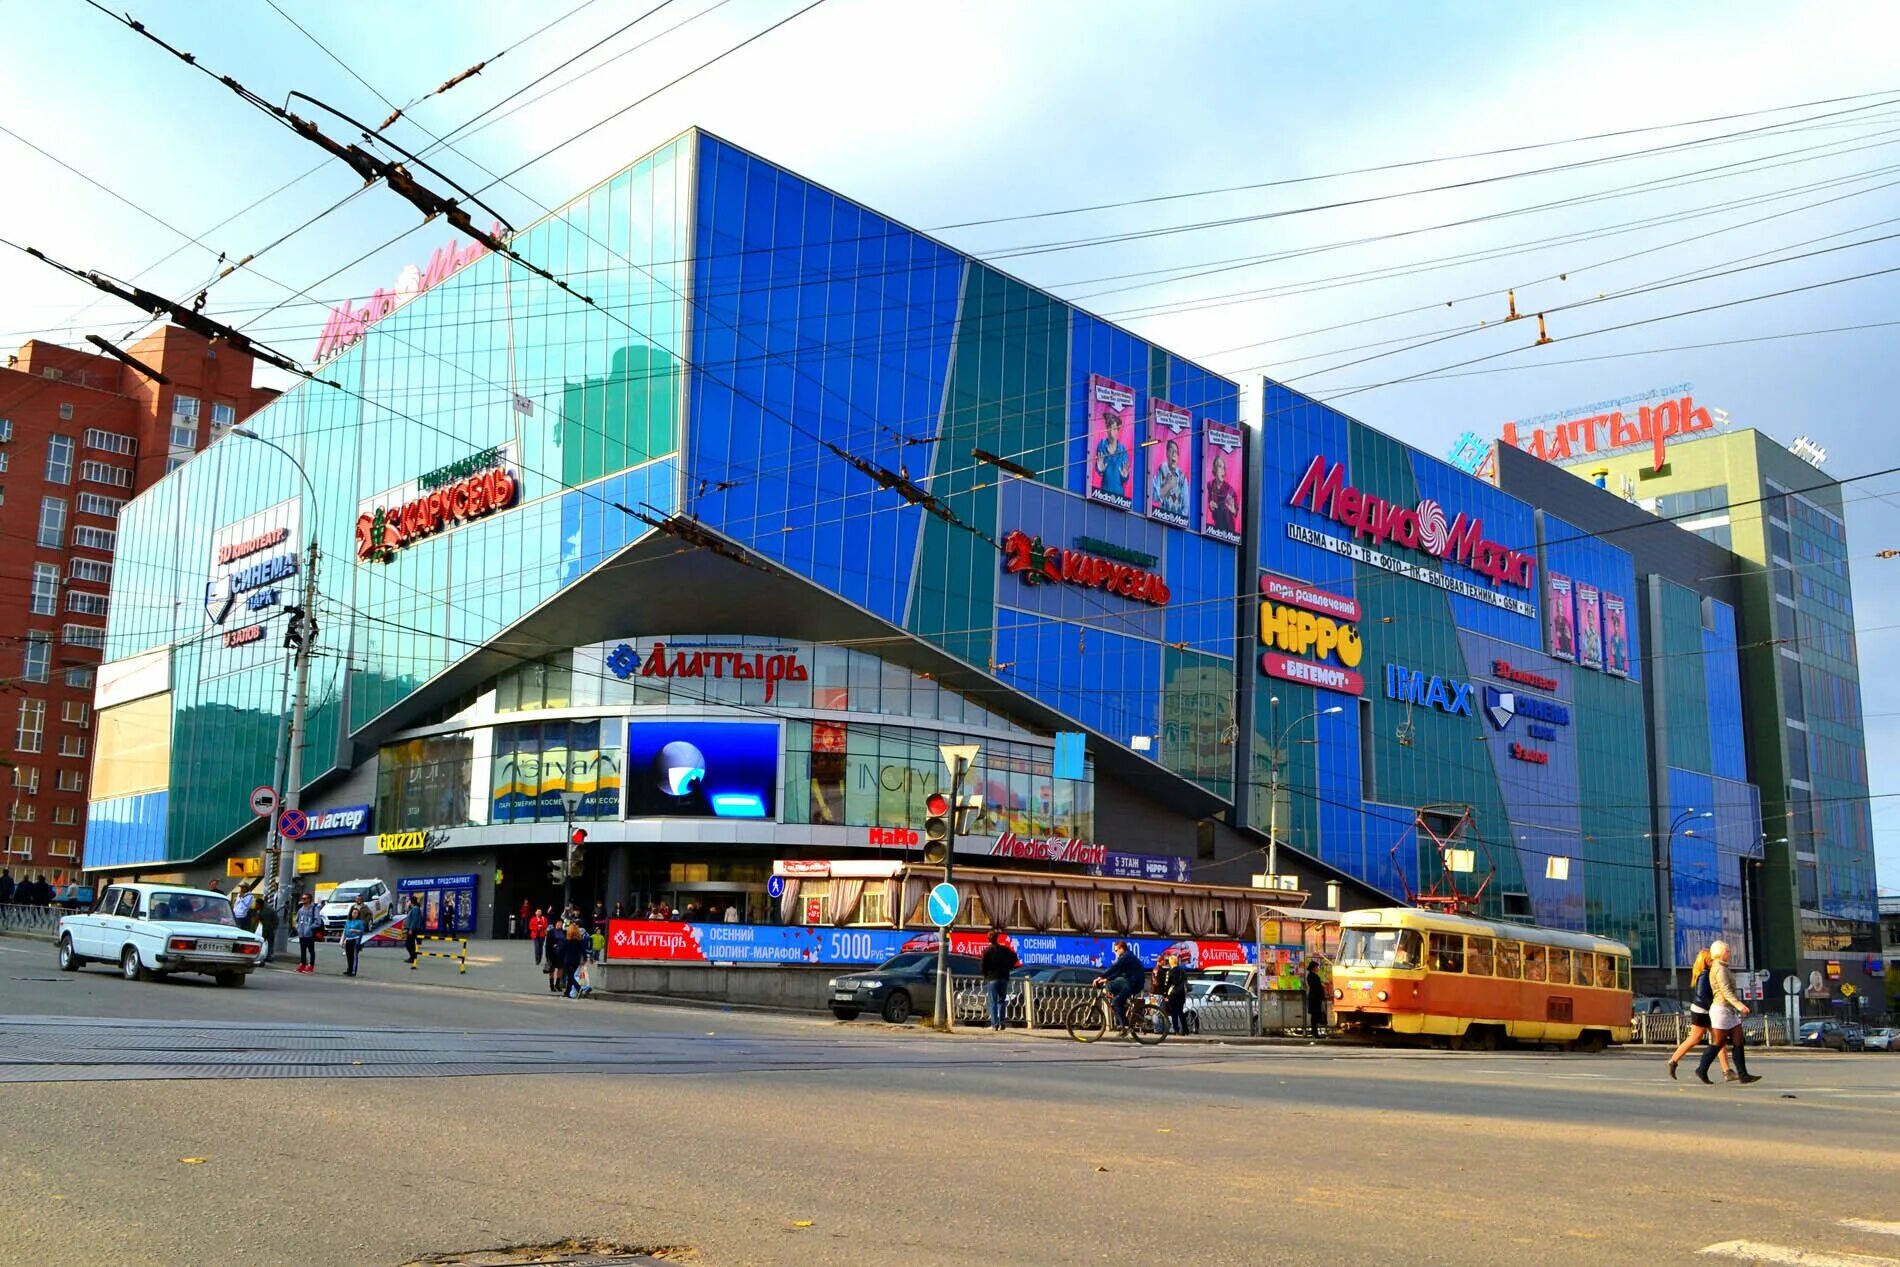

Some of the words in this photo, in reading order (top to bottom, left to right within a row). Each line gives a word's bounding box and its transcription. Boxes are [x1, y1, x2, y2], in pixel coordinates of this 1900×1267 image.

[400, 466, 515, 541] КАРУСЕЛЬ
[1291, 455, 1421, 549] Медиа
[1442, 511, 1536, 589] Маркт
[231, 553, 297, 593] СИНЕМА
[1061, 550, 1171, 605] КАРУСЕЛЬ
[1288, 524, 1327, 548] ПЛАЗМА
[1335, 539, 1352, 556] LCD
[1361, 548, 1372, 562] ТВ
[1380, 555, 1402, 571] ФОТО
[1428, 571, 1464, 593] БЫТОВАЯ
[1465, 584, 1497, 603] ТЕХНИКА
[1503, 597, 1518, 610] GSM
[247, 589, 276, 611] ПАРК
[1270, 581, 1295, 598] парк
[1296, 590, 1355, 615] развлечений
[231, 625, 261, 644] ЗАЛОВ
[642, 643, 808, 703] Алатырь
[1286, 660, 1345, 688] БЕГЕМОТ
[1386, 664, 1473, 717] IMAX
[858, 763, 931, 794] INCITY
[378, 832, 427, 851] GRIZZLY
[990, 832, 1049, 859] Media
[1060, 838, 1107, 864] Markt
[1121, 857, 1139, 868] ЭТАЖ
[626, 931, 686, 954] Алатырь
[710, 927, 754, 941] ОСЕННИЙ
[831, 933, 871, 960] 5000
[1023, 938, 1056, 950] ОСЕННИЙ
[709, 945, 801, 960] ШОПИНГ-МАРАФОН
[1023, 953, 1089, 965] ШОПИНГ-МАРАФОН
